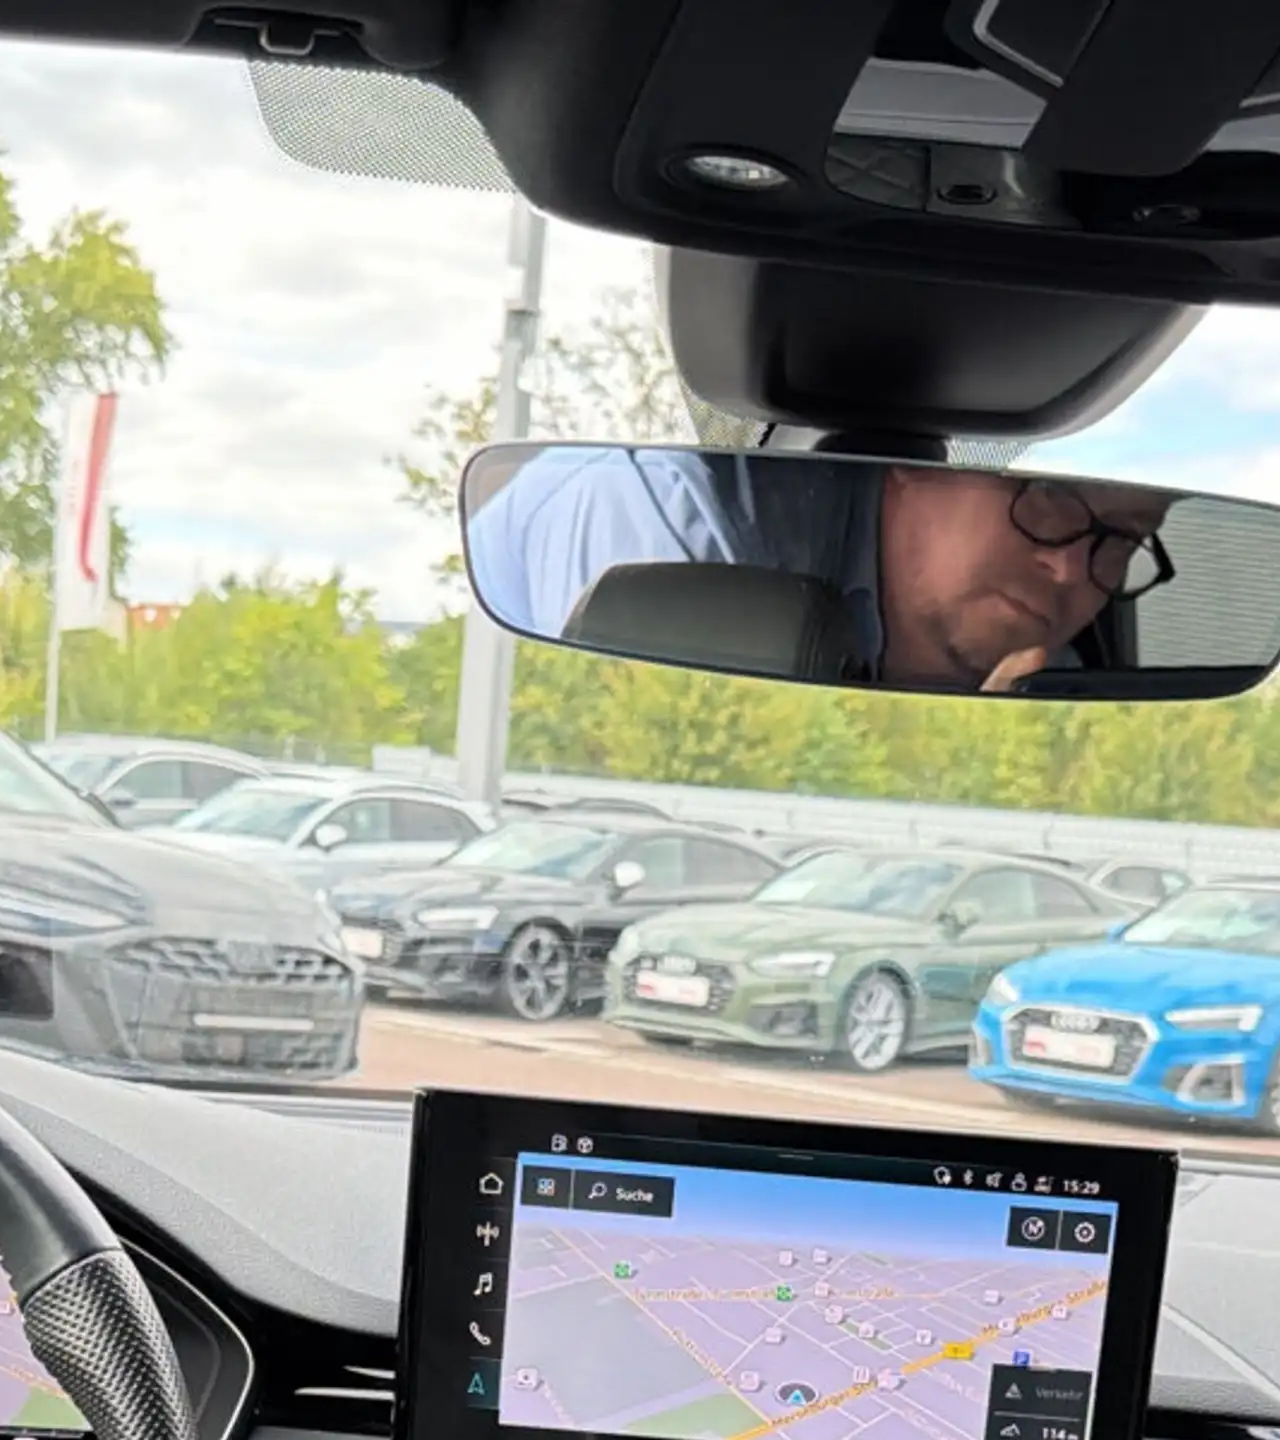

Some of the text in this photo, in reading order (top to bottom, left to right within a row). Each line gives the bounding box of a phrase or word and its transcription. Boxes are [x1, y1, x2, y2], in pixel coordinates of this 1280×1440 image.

[616, 1186, 654, 1204] Suche
[1062, 1179, 1100, 1195] 15:29
[1042, 1426, 1066, 1440] 114
